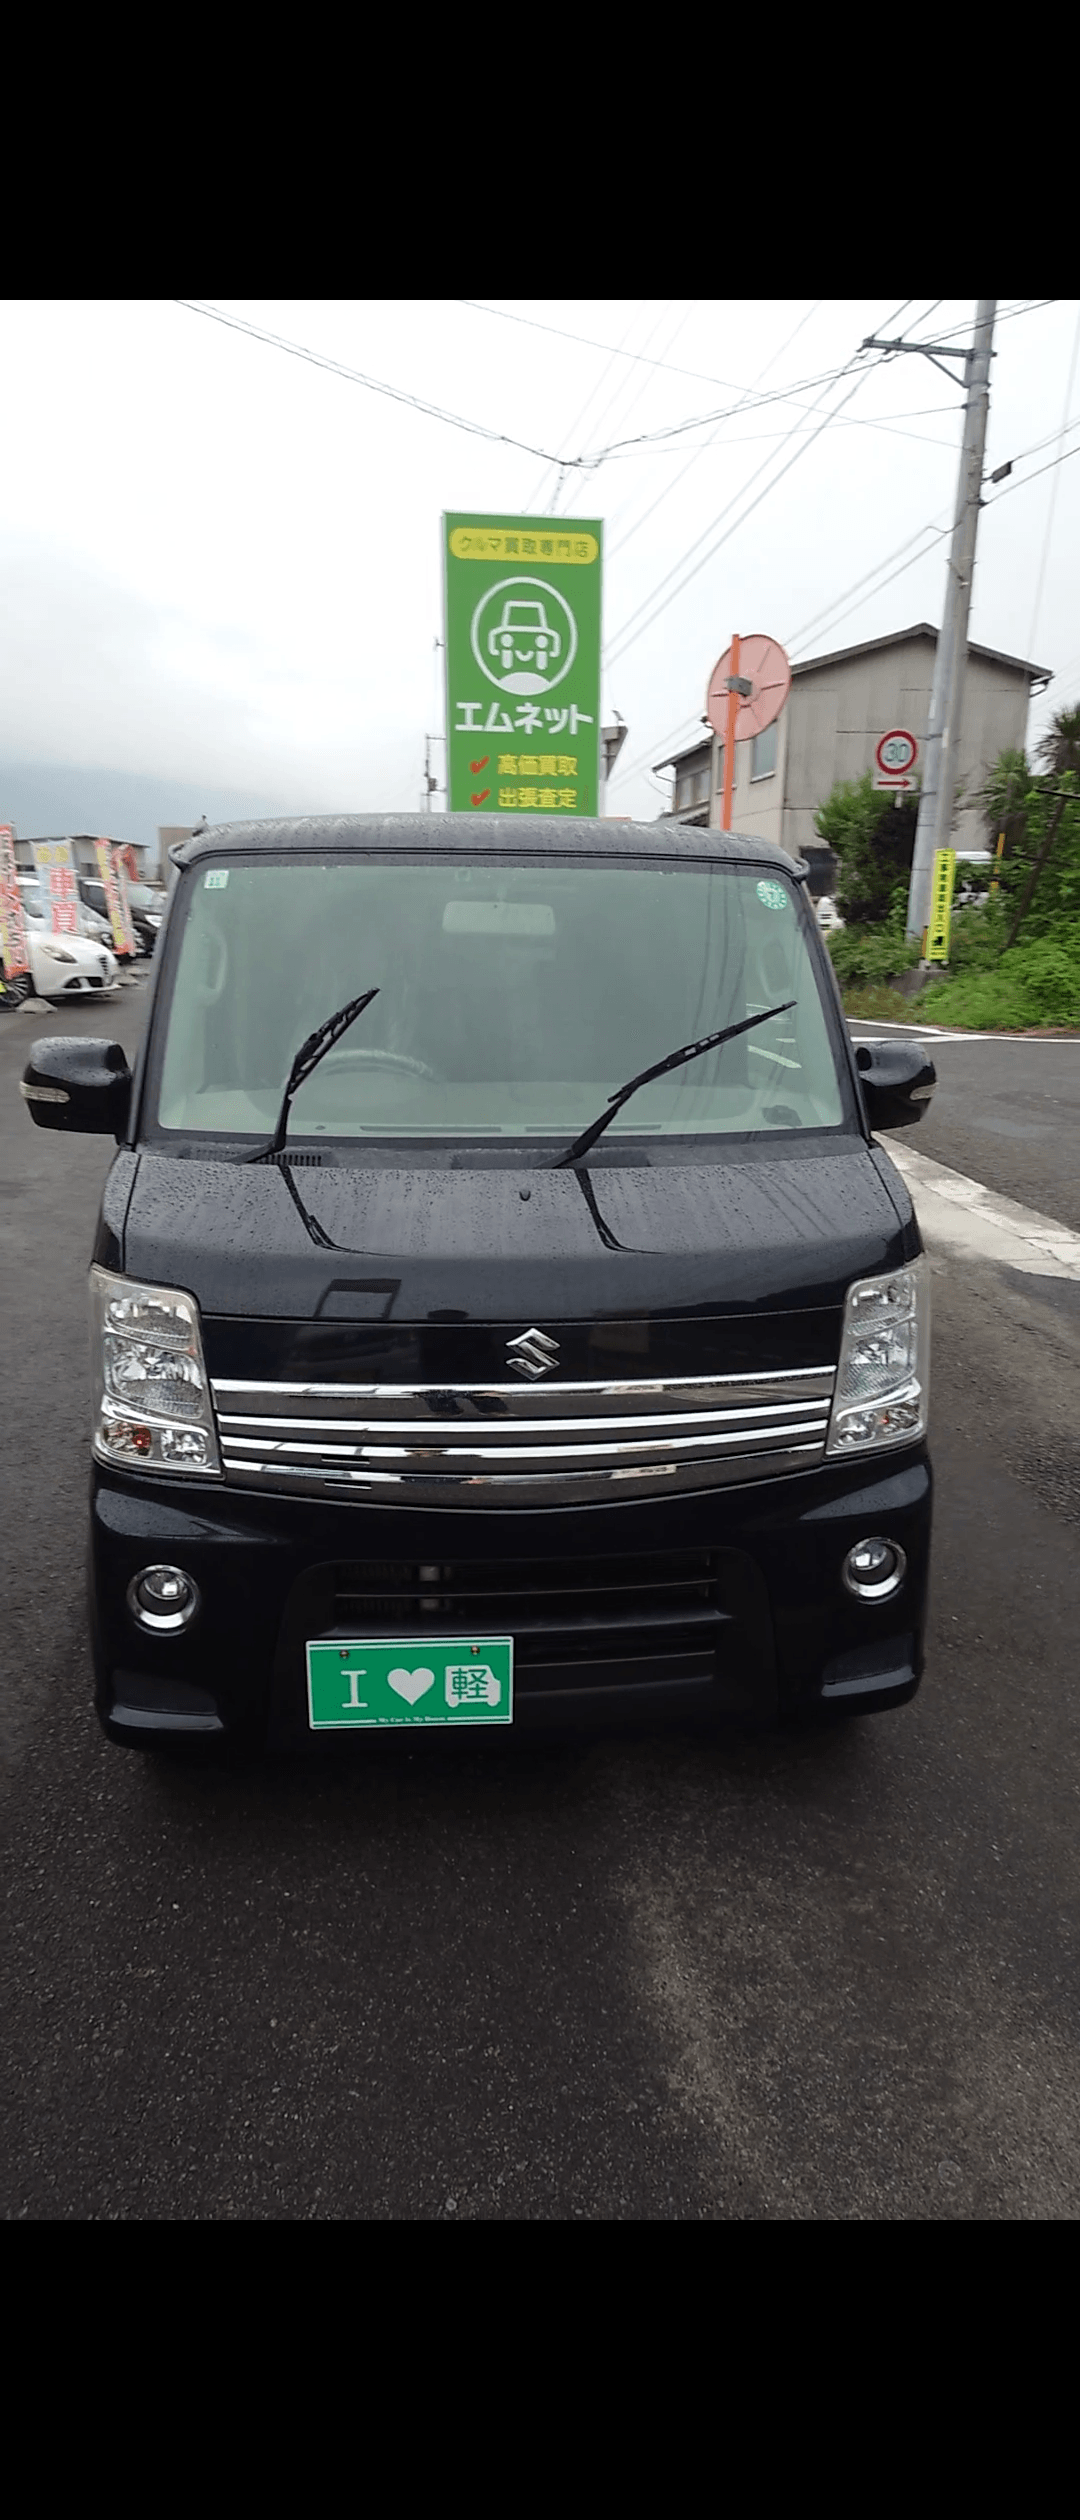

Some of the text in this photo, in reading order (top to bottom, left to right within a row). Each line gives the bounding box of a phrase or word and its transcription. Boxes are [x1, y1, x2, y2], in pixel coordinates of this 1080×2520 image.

[459, 535, 588, 558] クルマ買取専門店
[455, 702, 594, 735] エムネット
[885, 743, 911, 762] 30
[498, 754, 578, 776] 高価買取
[498, 787, 577, 808] 出張査定
[451, 1668, 489, 1699] 軽
